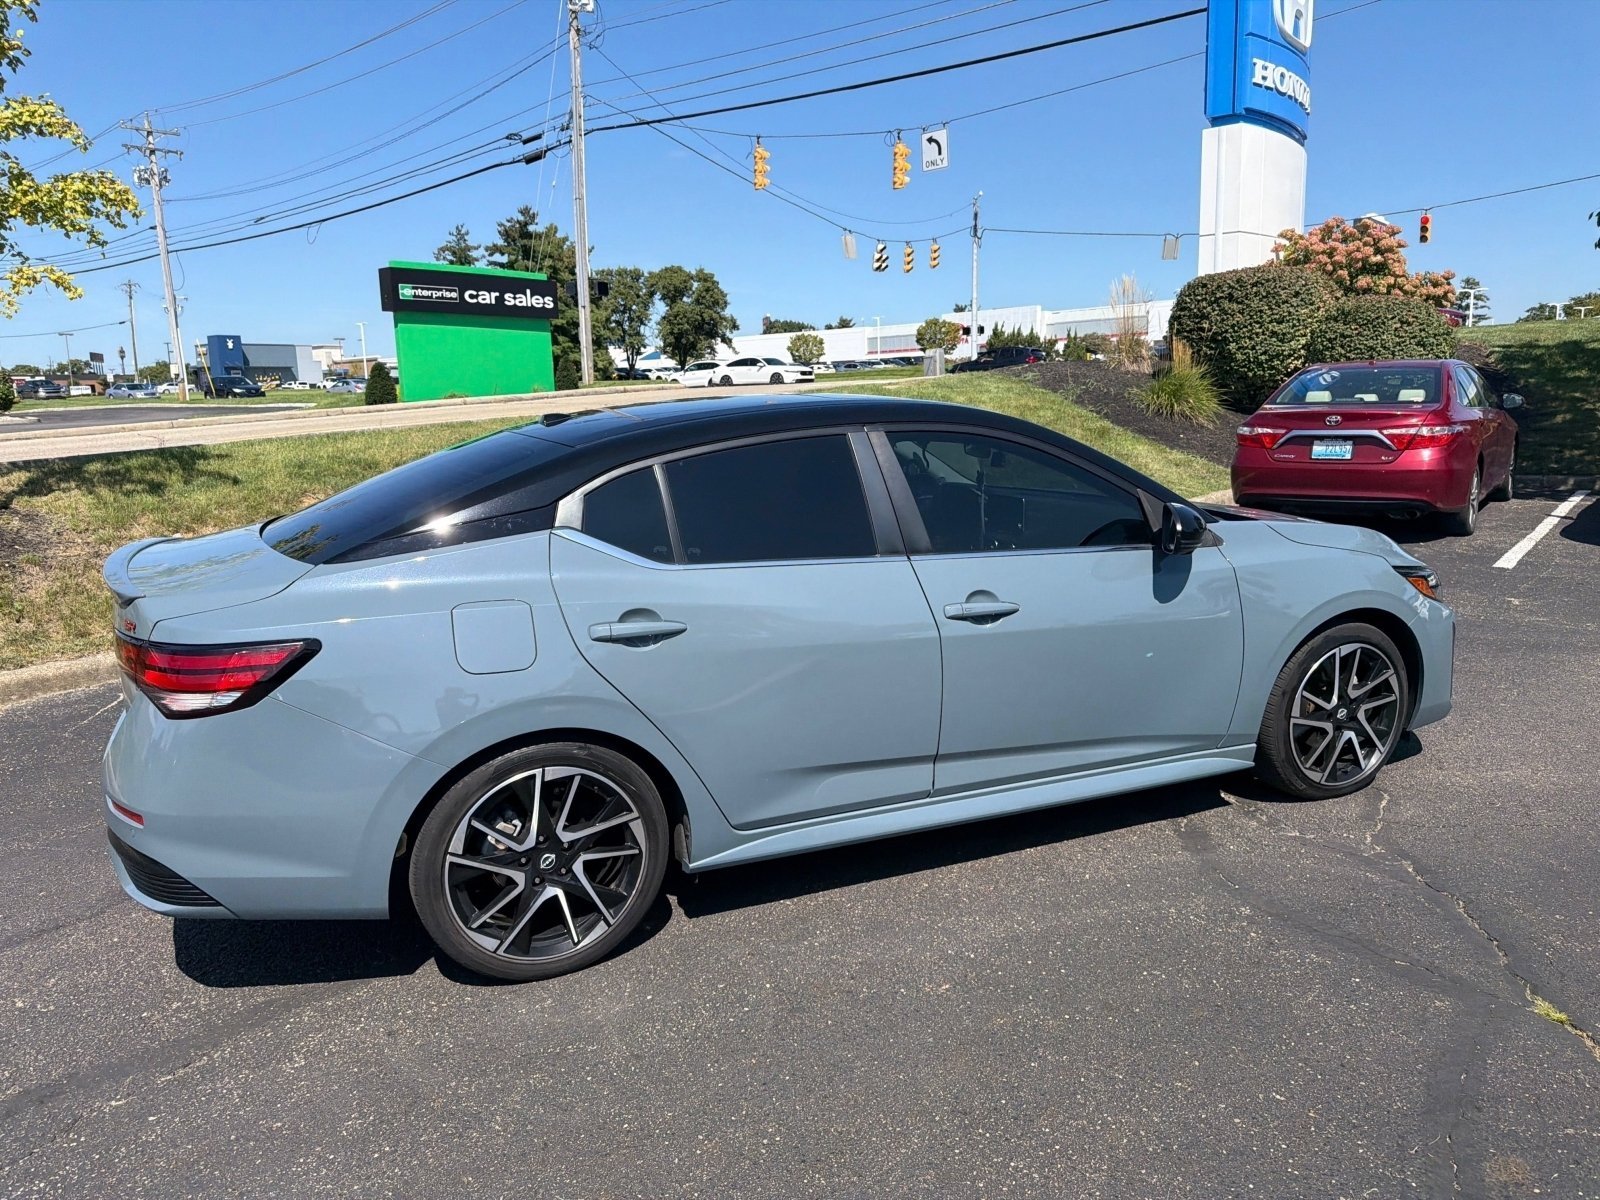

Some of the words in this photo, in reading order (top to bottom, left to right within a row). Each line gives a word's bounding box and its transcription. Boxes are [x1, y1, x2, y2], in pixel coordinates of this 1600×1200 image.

[926, 157, 945, 168] ONLY
[402, 287, 458, 299] enterprise
[464, 289, 500, 305] car
[503, 288, 555, 309] sales
